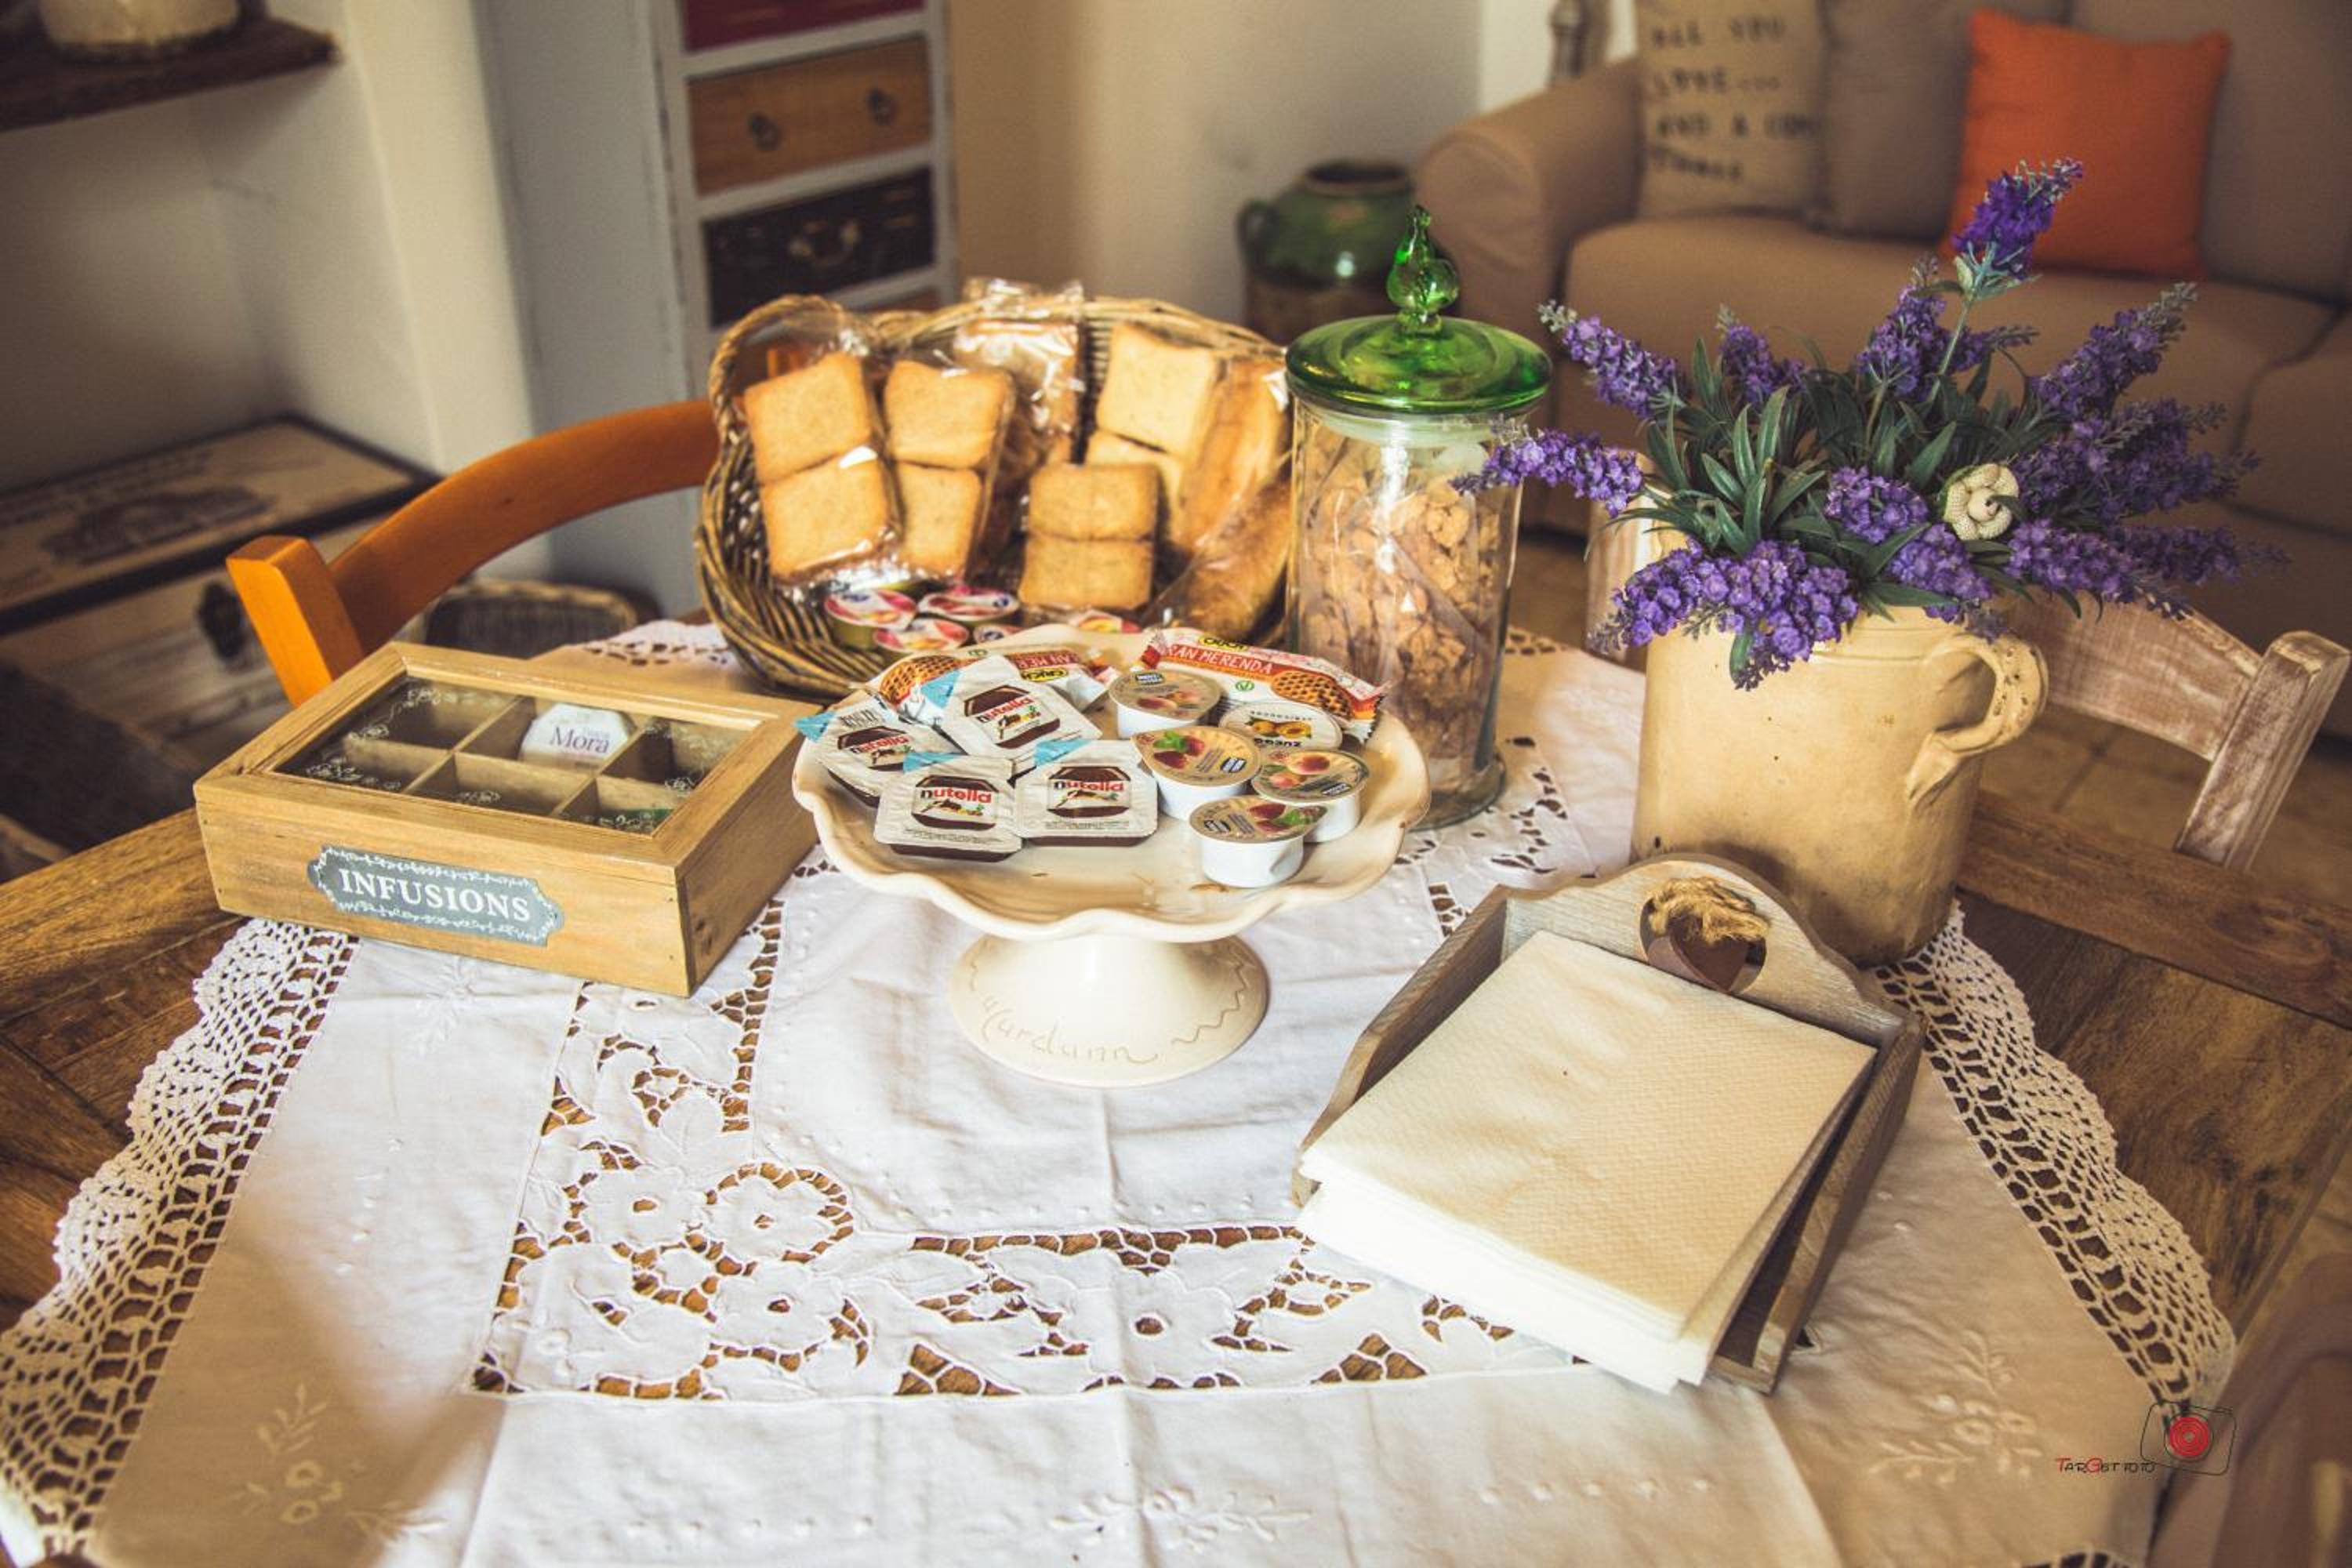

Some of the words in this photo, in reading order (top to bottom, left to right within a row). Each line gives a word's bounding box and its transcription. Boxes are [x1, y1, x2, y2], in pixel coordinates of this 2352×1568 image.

[1197, 649, 1274, 675] MERENDA
[976, 695, 1036, 724] nutella
[550, 726, 609, 753] Mora
[850, 735, 910, 754] nutella
[920, 787, 993, 804] nutella
[1054, 779, 1124, 792] nutella
[338, 868, 531, 922] INFUSIONS
